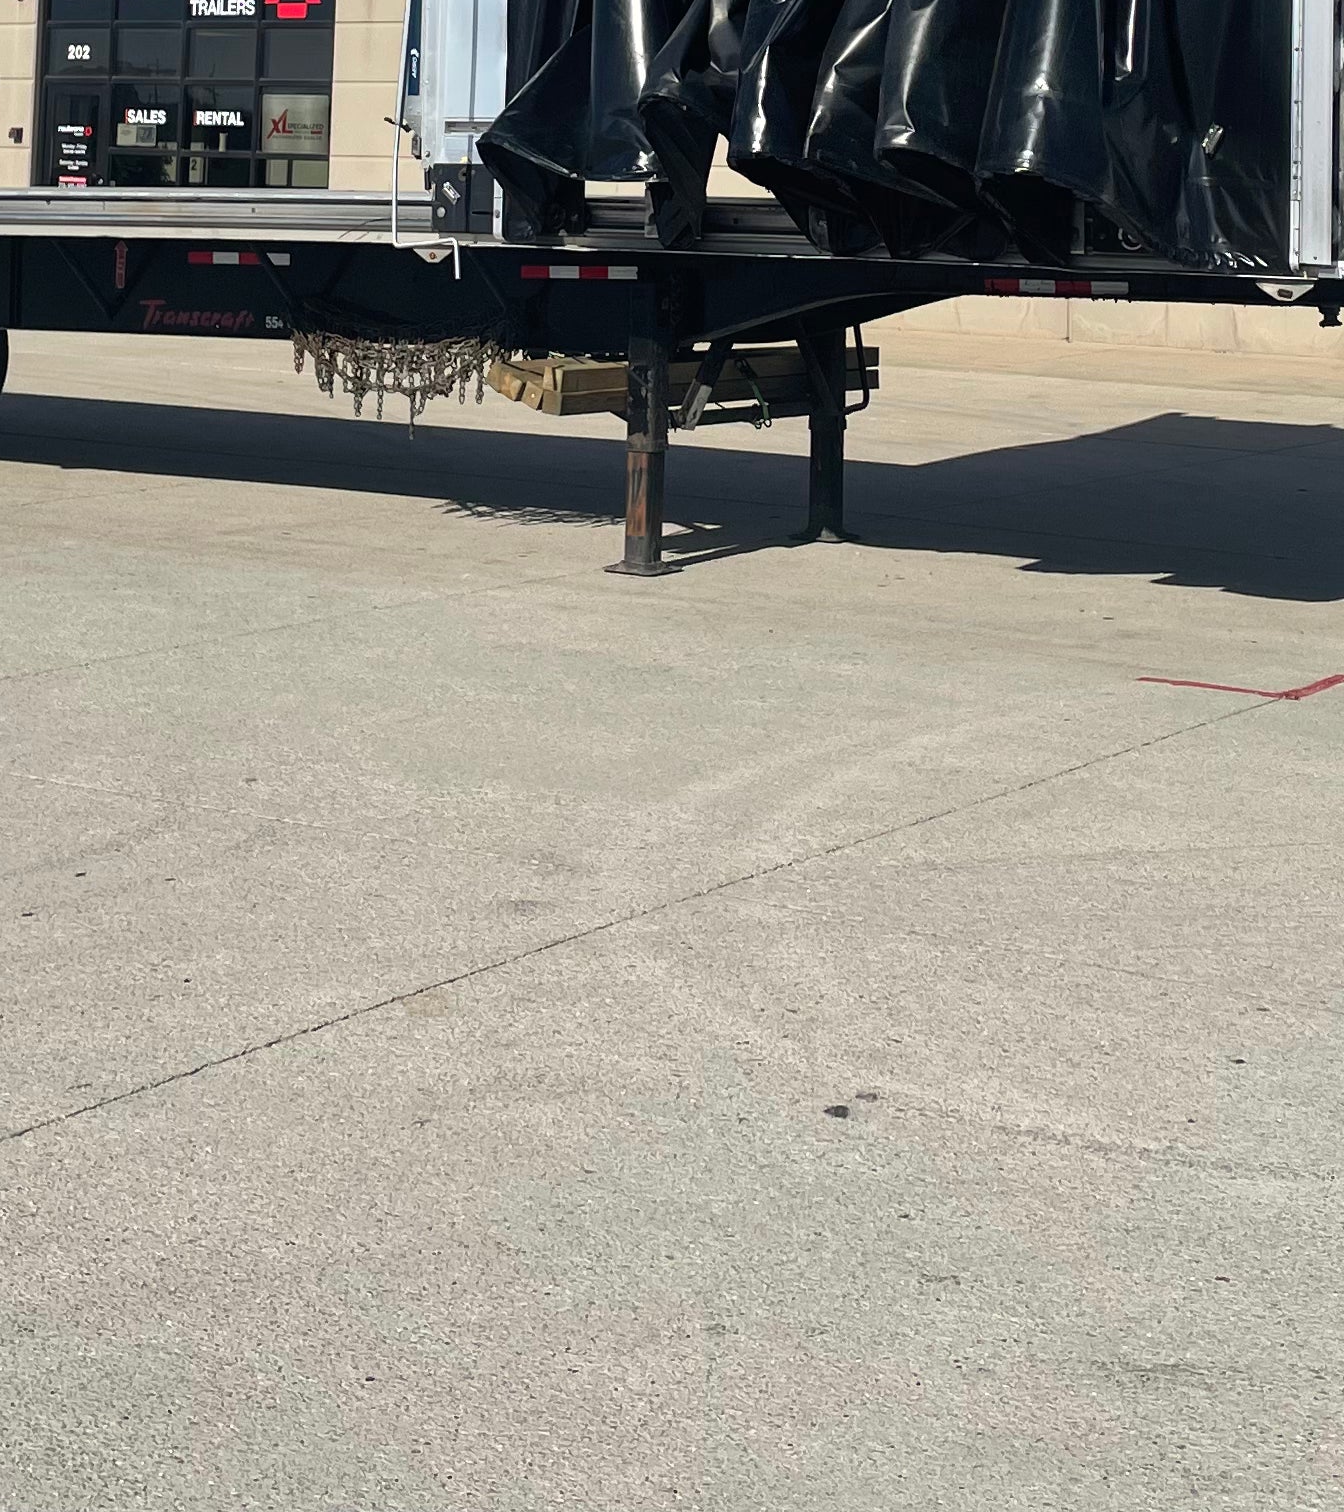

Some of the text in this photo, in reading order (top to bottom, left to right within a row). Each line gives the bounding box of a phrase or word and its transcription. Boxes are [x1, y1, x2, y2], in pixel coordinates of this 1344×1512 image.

[67, 44, 91, 60] 202
[127, 108, 167, 125] SALES
[195, 110, 244, 126] RENTAL
[267, 108, 294, 139] XL
